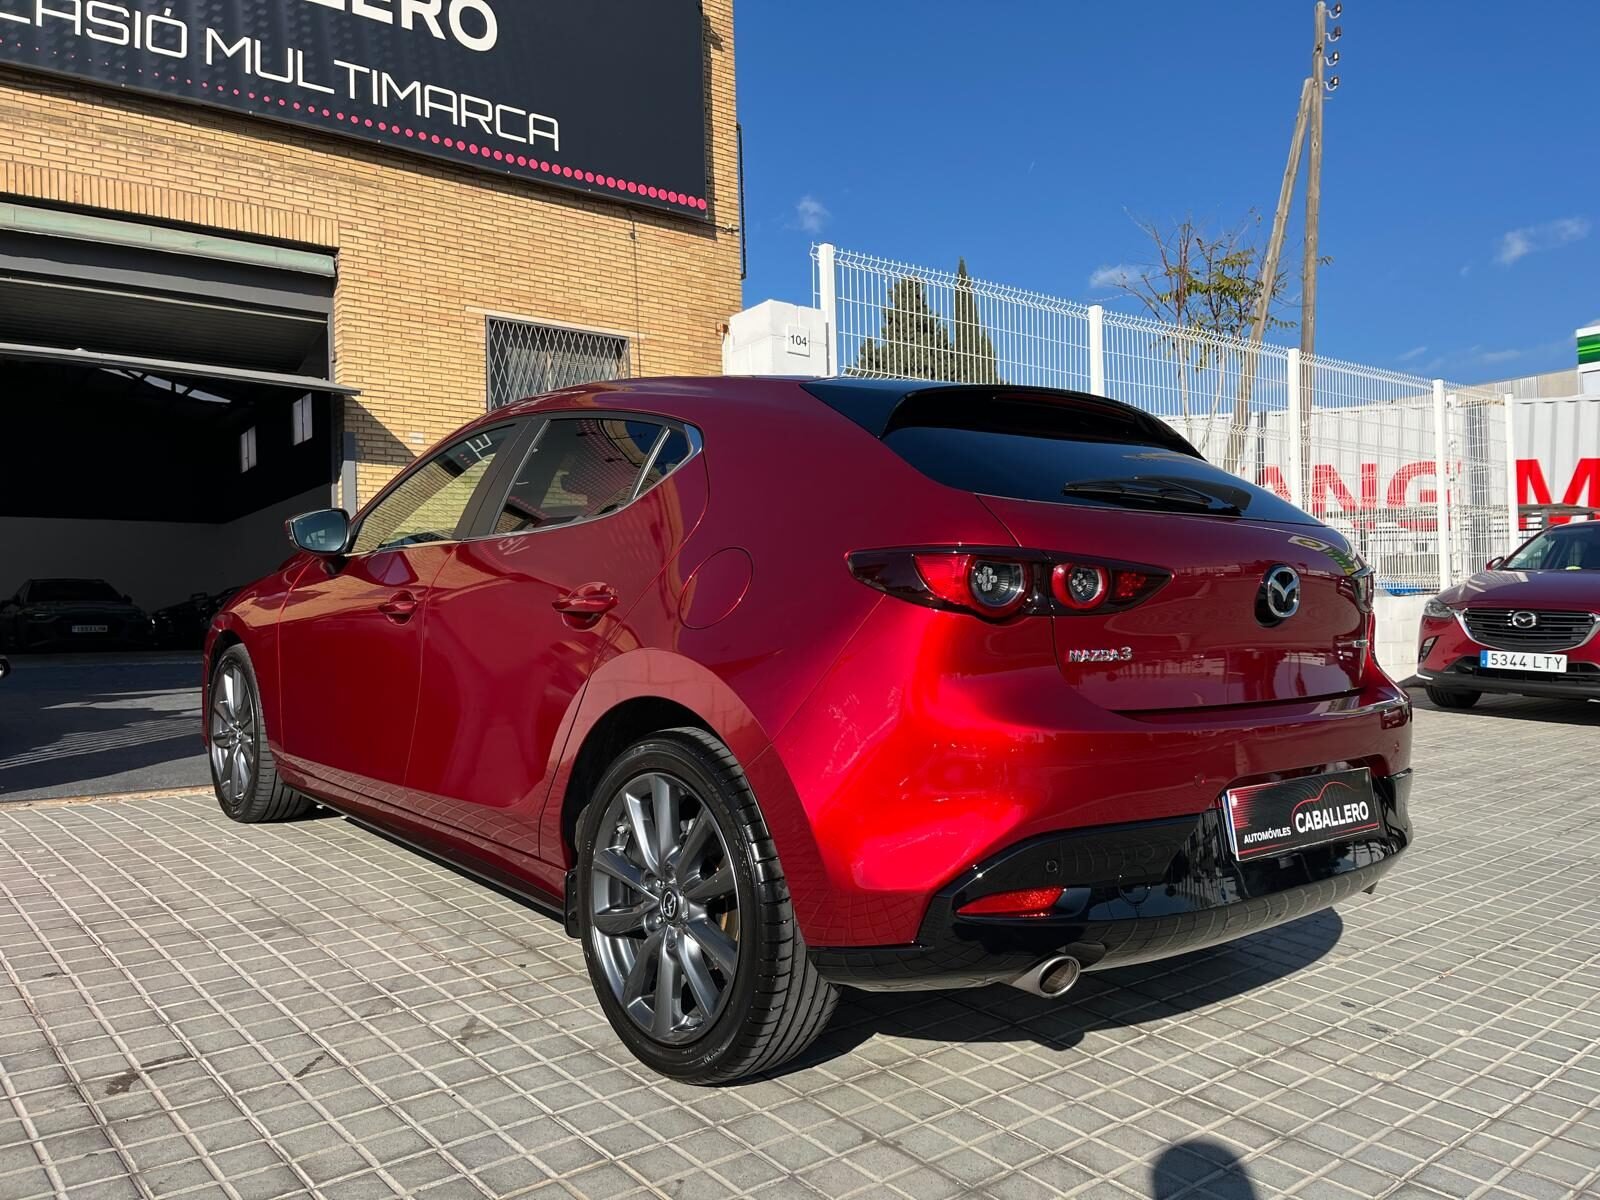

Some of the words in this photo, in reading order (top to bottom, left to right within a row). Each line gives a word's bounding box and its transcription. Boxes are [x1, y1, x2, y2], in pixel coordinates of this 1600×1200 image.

[0, 0, 188, 58] ASIÓ
[206, 27, 559, 152] MULTIMARCA
[791, 335, 807, 347] 104
[1069, 646, 1132, 662] MAZDA3
[1491, 653, 1527, 667] 5344
[1533, 655, 1563, 669] LTY
[1243, 827, 1292, 844] AUTOMÓVILES
[1295, 801, 1369, 833] CABALLERO
